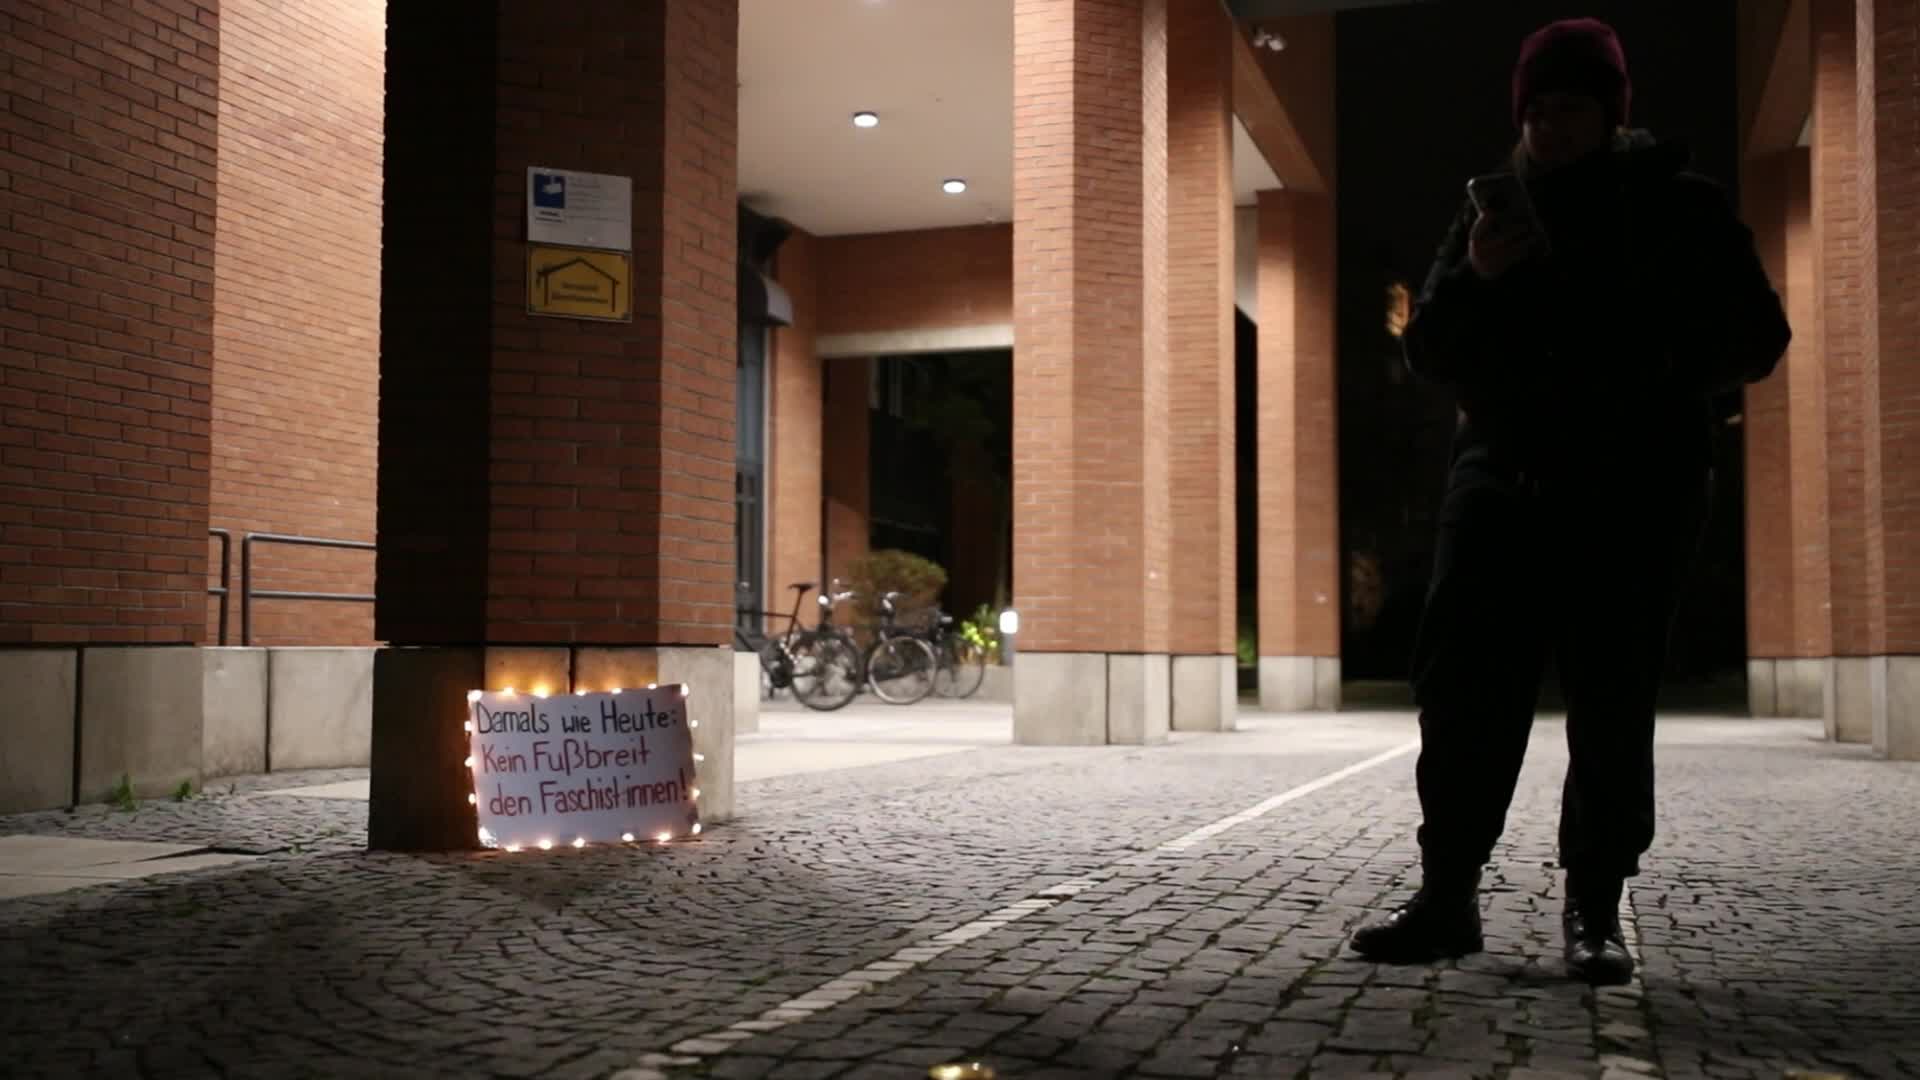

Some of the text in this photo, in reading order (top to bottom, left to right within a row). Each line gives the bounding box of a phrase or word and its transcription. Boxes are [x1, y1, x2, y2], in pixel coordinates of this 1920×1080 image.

[476, 699, 678, 734] Damals wie Heute:
[481, 736, 650, 776] Kein Fußbreit
[489, 785, 532, 816] den
